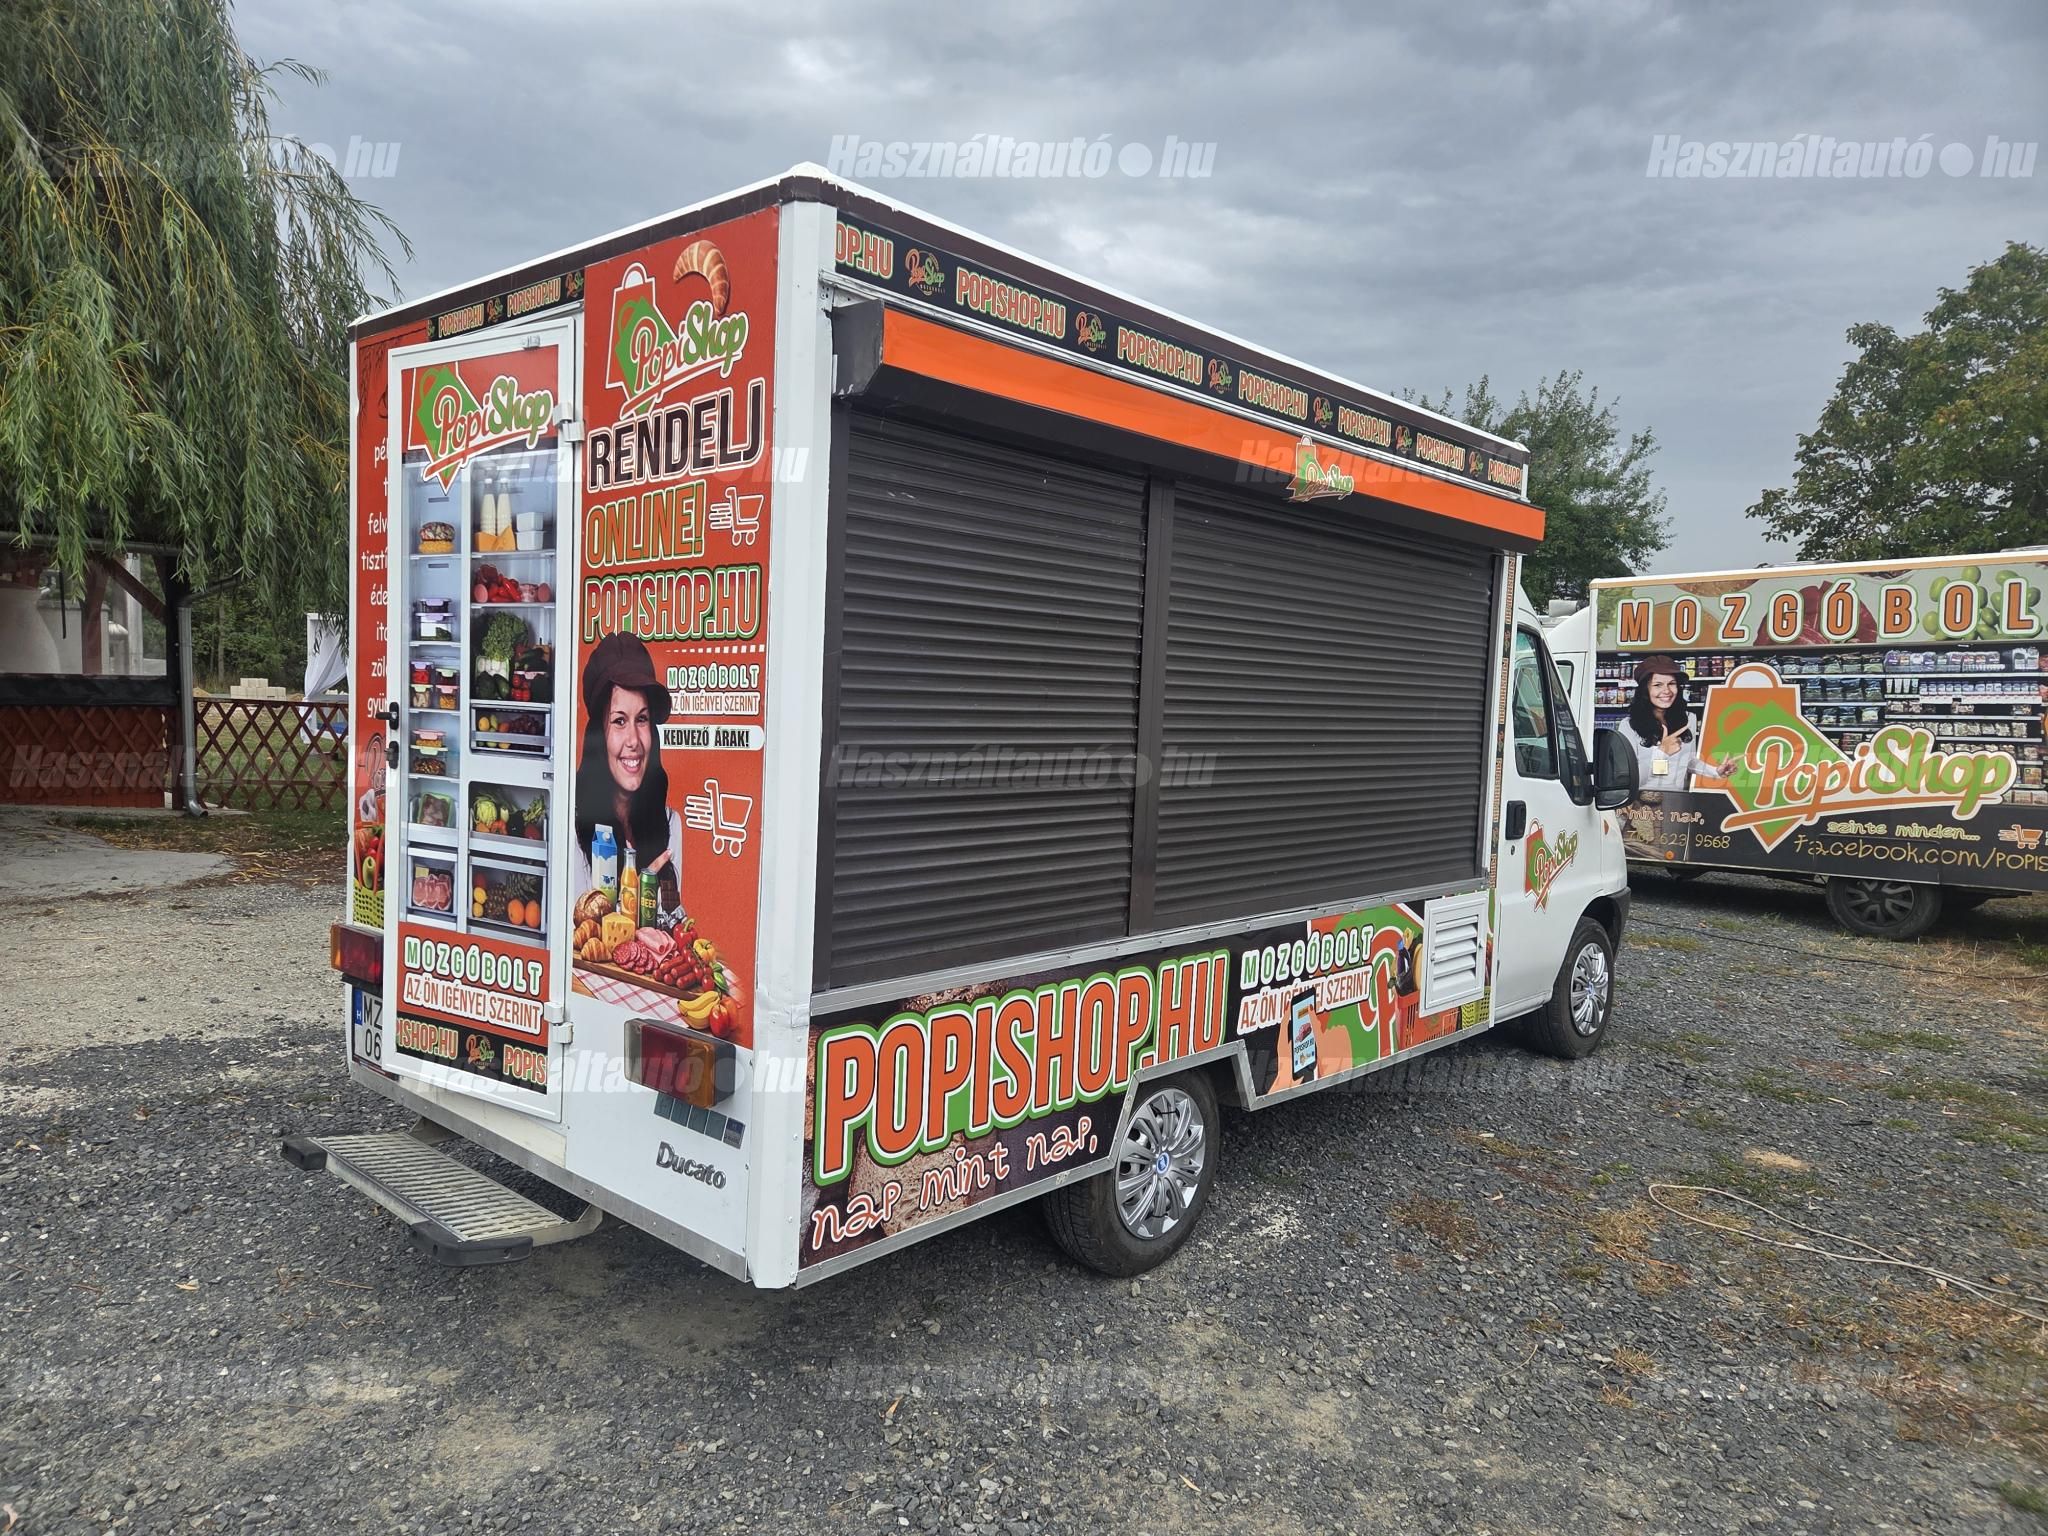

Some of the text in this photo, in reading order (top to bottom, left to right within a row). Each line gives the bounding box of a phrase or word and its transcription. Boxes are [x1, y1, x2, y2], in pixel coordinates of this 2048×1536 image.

[507, 277, 562, 317] POPISHOP.HU
[956, 266, 1067, 339] POPISHOP.HU
[1117, 326, 1204, 385] POPISHOP.HU
[1238, 369, 1309, 420] POPISHOP.HU
[587, 377, 766, 493] RENDELJ
[586, 480, 707, 569] ONLINE!
[583, 564, 763, 643] POPISHOP.HU
[1618, 577, 2041, 646] MOZGÓBOL
[667, 661, 760, 689] MOZGÓBOLT
[724, 695, 759, 712] SZERINT
[663, 726, 750, 747] KEDVEZŐ ÁRAK!
[1743, 724, 2018, 820] PopiShop
[1695, 833, 1731, 849] 9568
[404, 935, 544, 996] MOZGÓBOLT
[1240, 925, 1375, 990] MOZGÓBOLT
[406, 976, 541, 1030] AZ ÖN IGÉNYEI SZERINT
[1240, 995, 1257, 1030] AZ
[1259, 990, 1277, 1024] ÖN
[1326, 970, 1371, 1006] SZERINT
[814, 951, 1229, 1184] POPISHOP.HU
[656, 1140, 727, 1190] Ducato
[811, 1181, 902, 1250] nap
[919, 1138, 1010, 1211] mint
